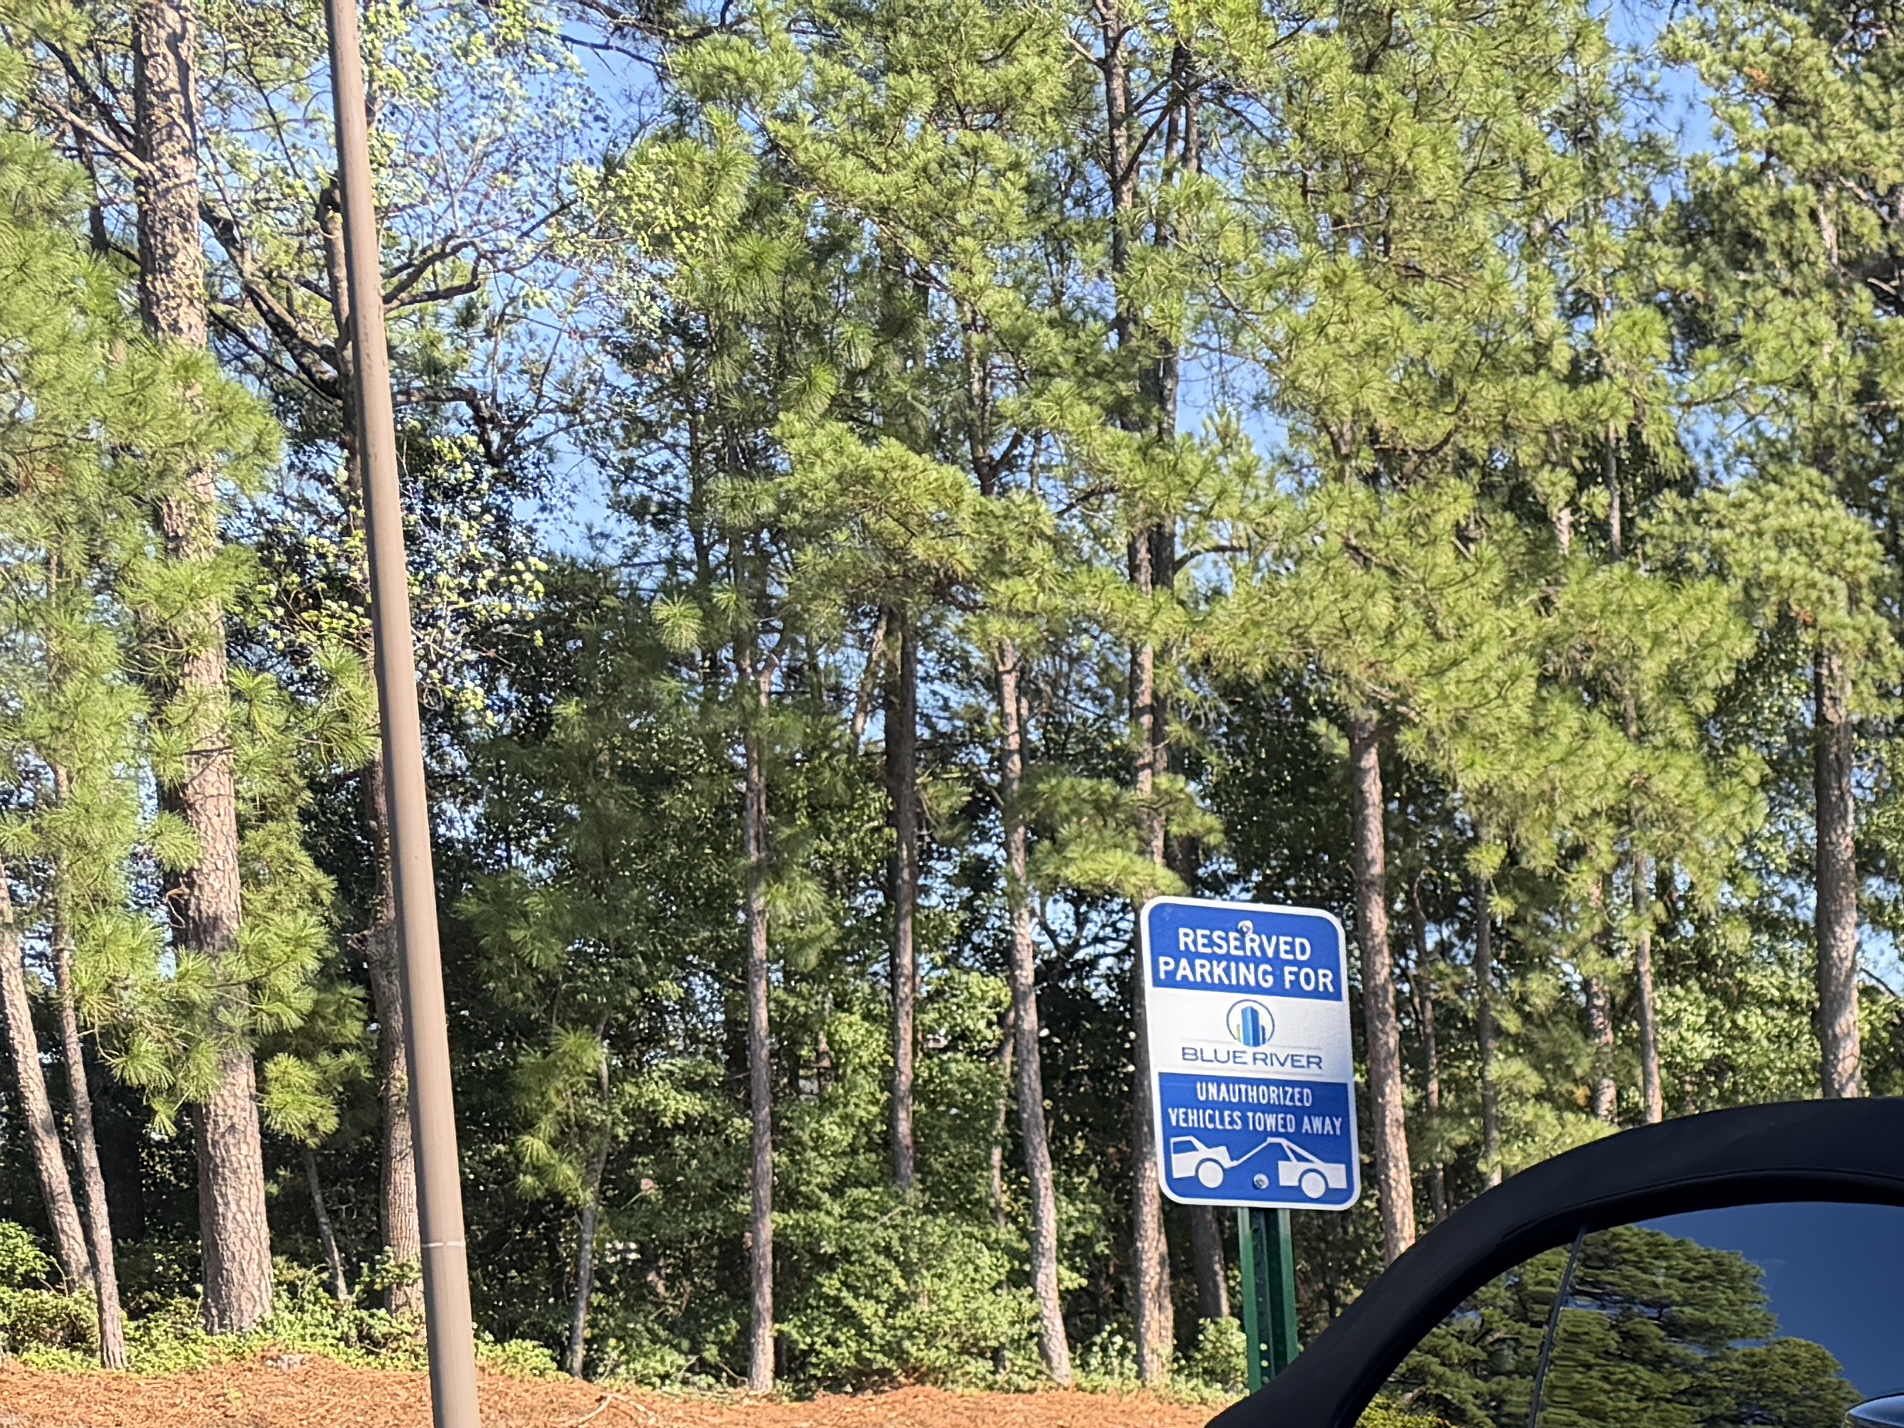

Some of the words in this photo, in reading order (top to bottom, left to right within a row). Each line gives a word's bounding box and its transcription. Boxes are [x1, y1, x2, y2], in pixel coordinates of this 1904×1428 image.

[1178, 927, 1311, 961] RESERVED
[1158, 956, 1275, 989] PARKING
[1284, 965, 1335, 993] FOR
[1181, 1046, 1247, 1065] BLUE
[1252, 1050, 1323, 1070] RIVER
[1195, 1082, 1312, 1107] UNAUTHORIZED
[1168, 1108, 1242, 1131] VEHICLES
[1247, 1112, 1296, 1134] TOWED
[1302, 1116, 1342, 1136] AWAY
